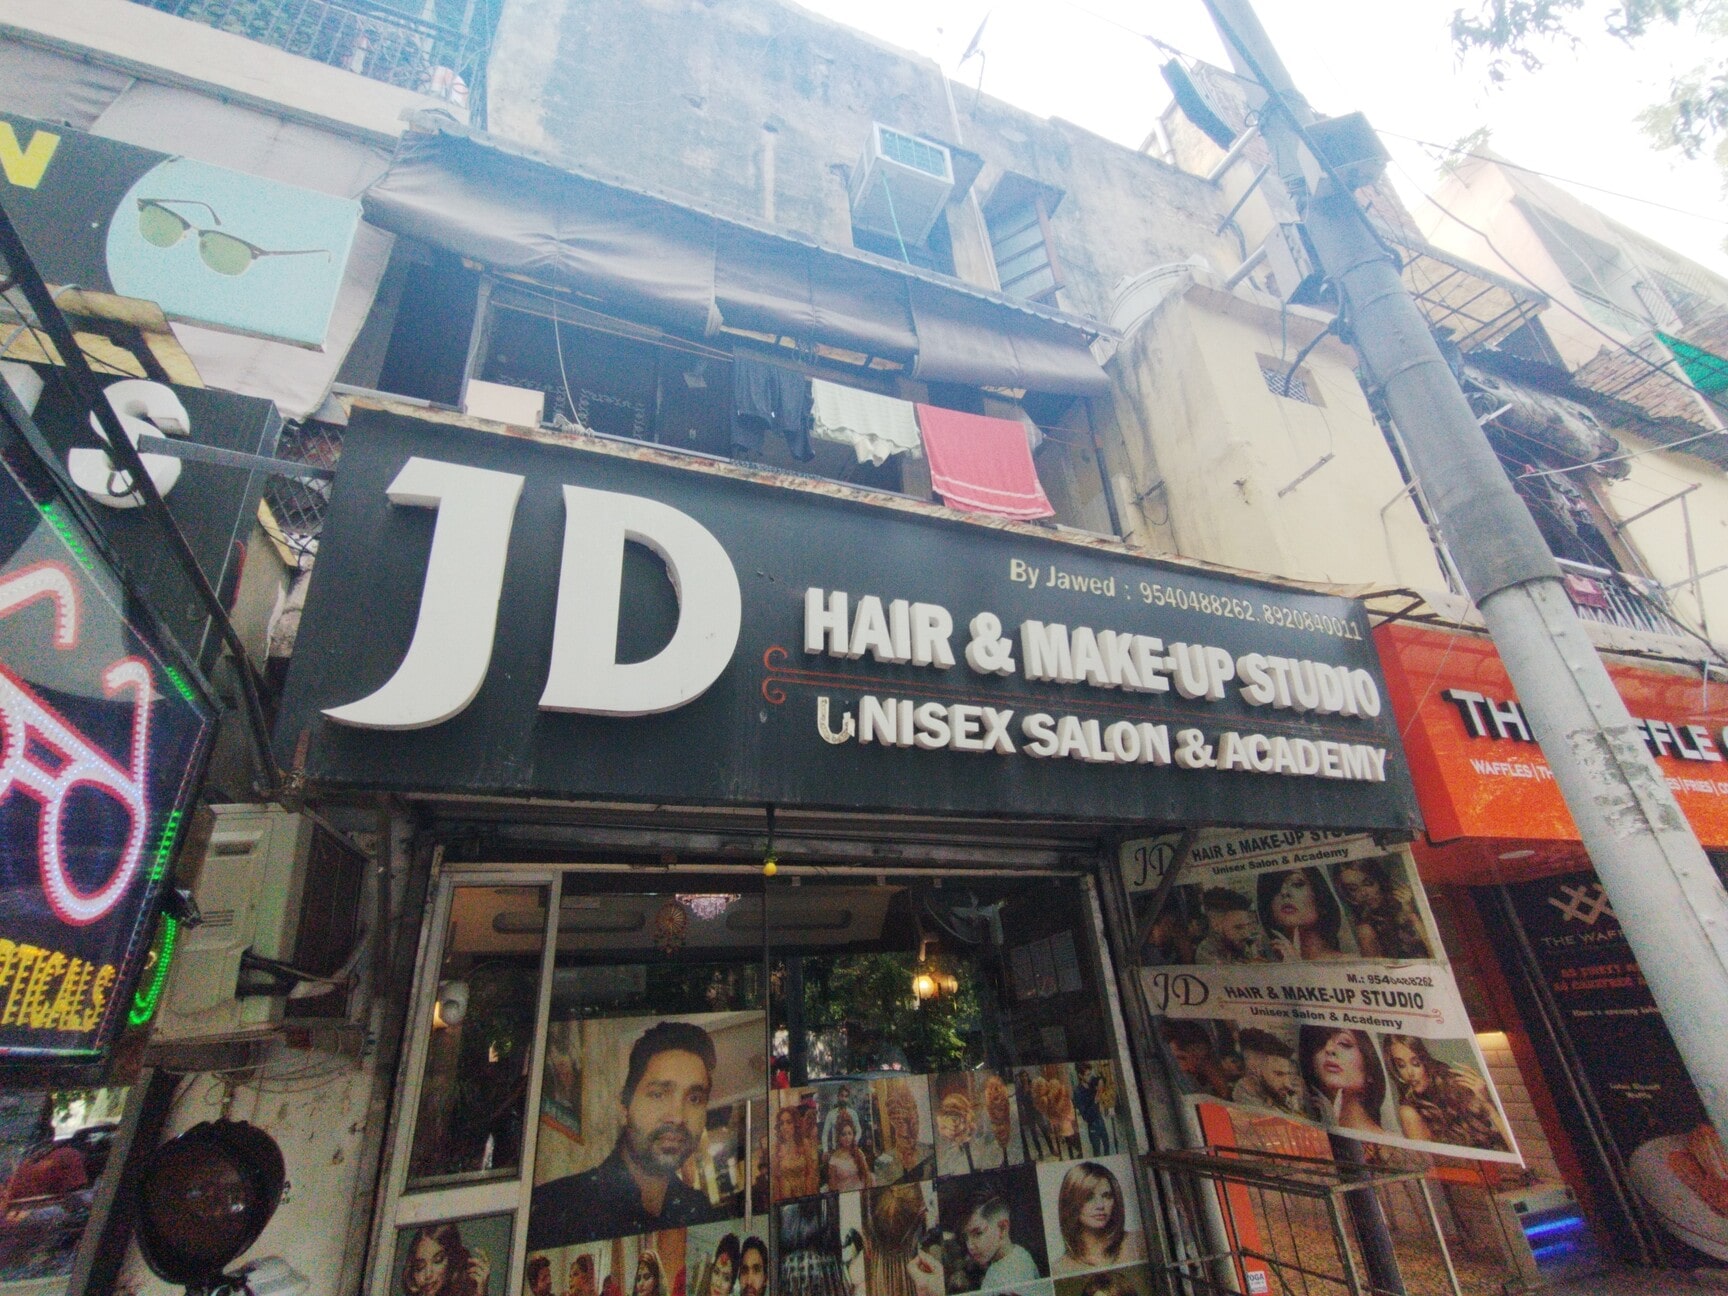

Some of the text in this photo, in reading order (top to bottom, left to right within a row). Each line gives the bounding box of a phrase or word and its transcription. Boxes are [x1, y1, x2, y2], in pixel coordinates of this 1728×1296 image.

[320, 456, 742, 731] JD
[1009, 558, 1040, 589] By
[1046, 565, 1116, 597] Jawed
[1262, 603, 1364, 641] 8920840011
[804, 587, 1382, 720] HAIR & MAKE-UP STUDIO
[1440, 688, 1537, 745] TH
[817, 695, 1386, 783] UNISEX SALON & ACADEMY
[1469, 758, 1533, 778] WAFFLES
[1192, 844, 1223, 863] HAIR
[1227, 842, 1237, 856] &
[1239, 829, 1305, 855] MAKE-UP
[1212, 846, 1350, 876] Unisex Salon & Academy
[1153, 972, 1210, 1011] JD
[1225, 986, 1425, 1011] HAIR & MAKE-UP STUDIO
[1250, 1005, 1403, 1030] Unisex Salon & Academy
